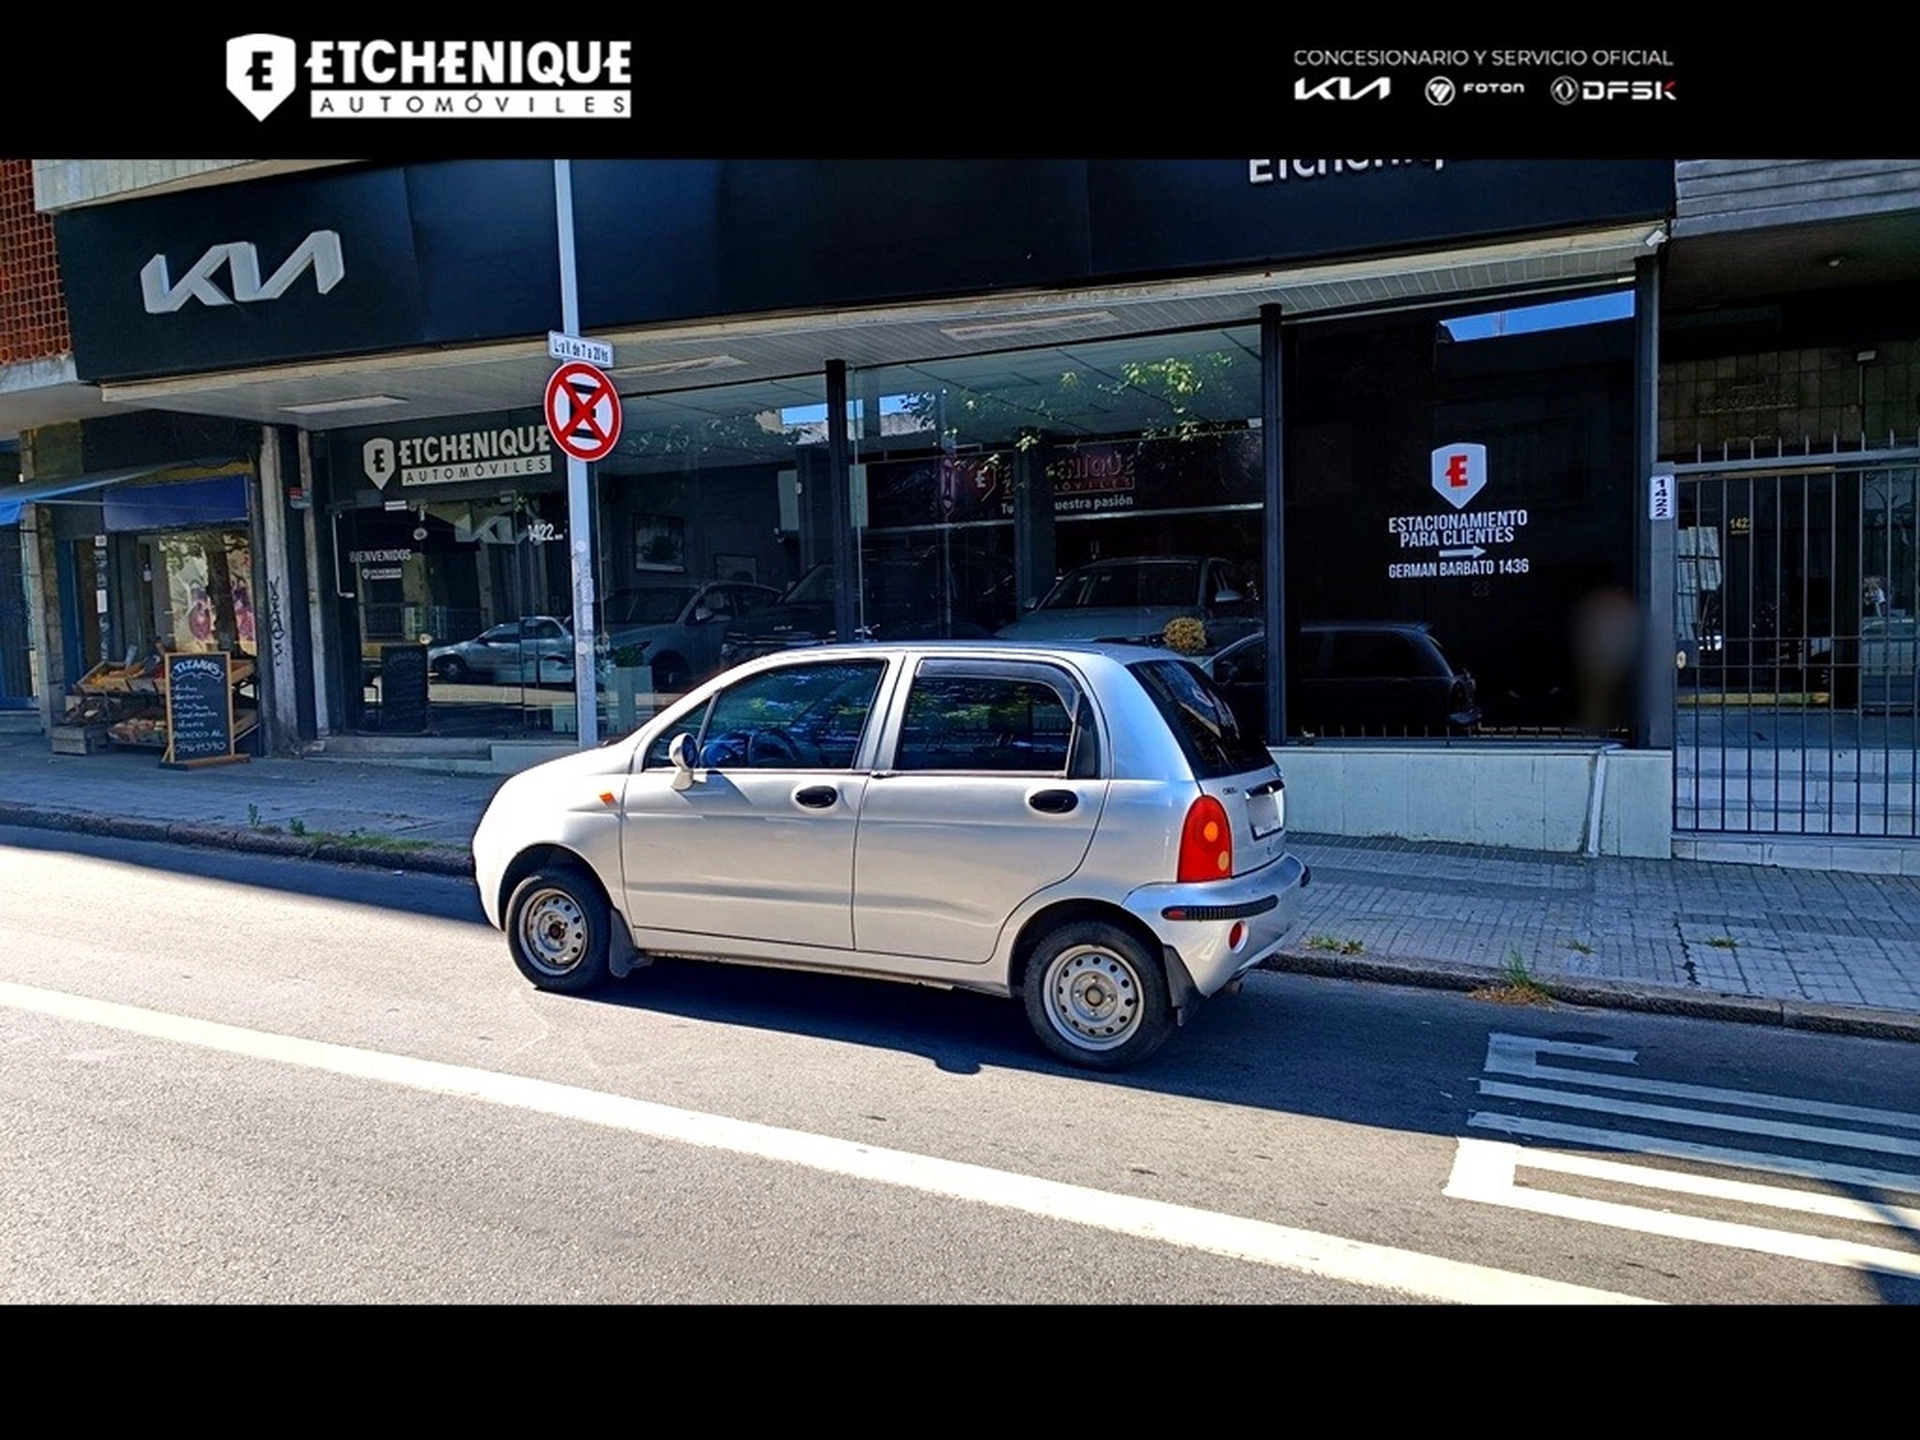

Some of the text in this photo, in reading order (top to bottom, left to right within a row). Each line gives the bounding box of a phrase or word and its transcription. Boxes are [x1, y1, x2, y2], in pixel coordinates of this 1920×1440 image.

[140, 229, 345, 314] KIA
[398, 425, 550, 466] ETCHENIQUE
[406, 459, 547, 482] AUTOMÓVILES
[1055, 499, 1092, 511] uestra
[1094, 495, 1133, 510] pasión
[1655, 479, 1668, 517] 1422
[1388, 509, 1528, 533] ESTACIONAMIENTO
[528, 524, 554, 541] 1422
[1400, 526, 1515, 548] PARA CLIENTES
[349, 548, 411, 563] BIENVENIDOS
[1388, 558, 1530, 578] GERMAN BARBATO 1436
